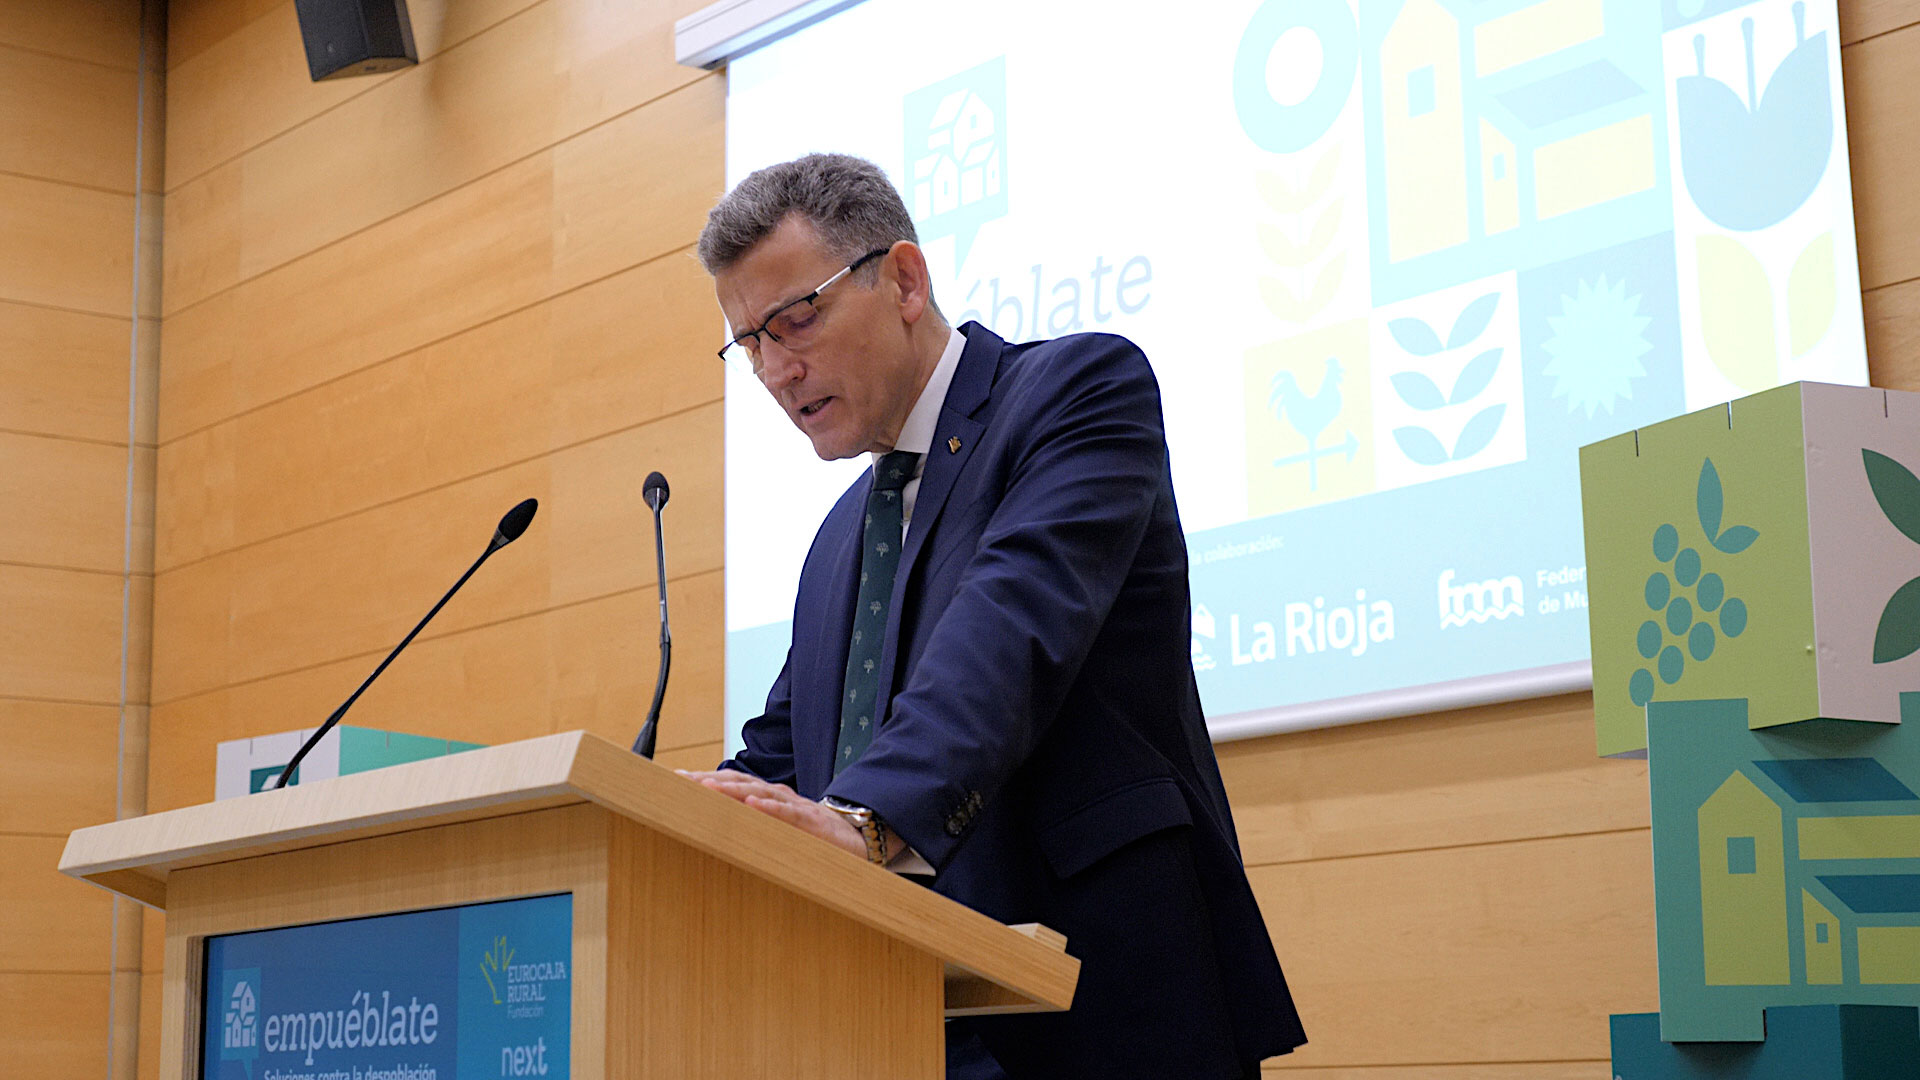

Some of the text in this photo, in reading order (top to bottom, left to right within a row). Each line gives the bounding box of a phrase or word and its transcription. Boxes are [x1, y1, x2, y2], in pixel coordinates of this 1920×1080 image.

[1538, 595, 1560, 615] de
[1230, 588, 1395, 666] La Rioja
[507, 962, 567, 983] EUROCAJA
[507, 984, 545, 1003] RURAL
[264, 990, 438, 1065] empuéblate
[501, 1036, 548, 1077] next
[352, 1065, 362, 1080] la
